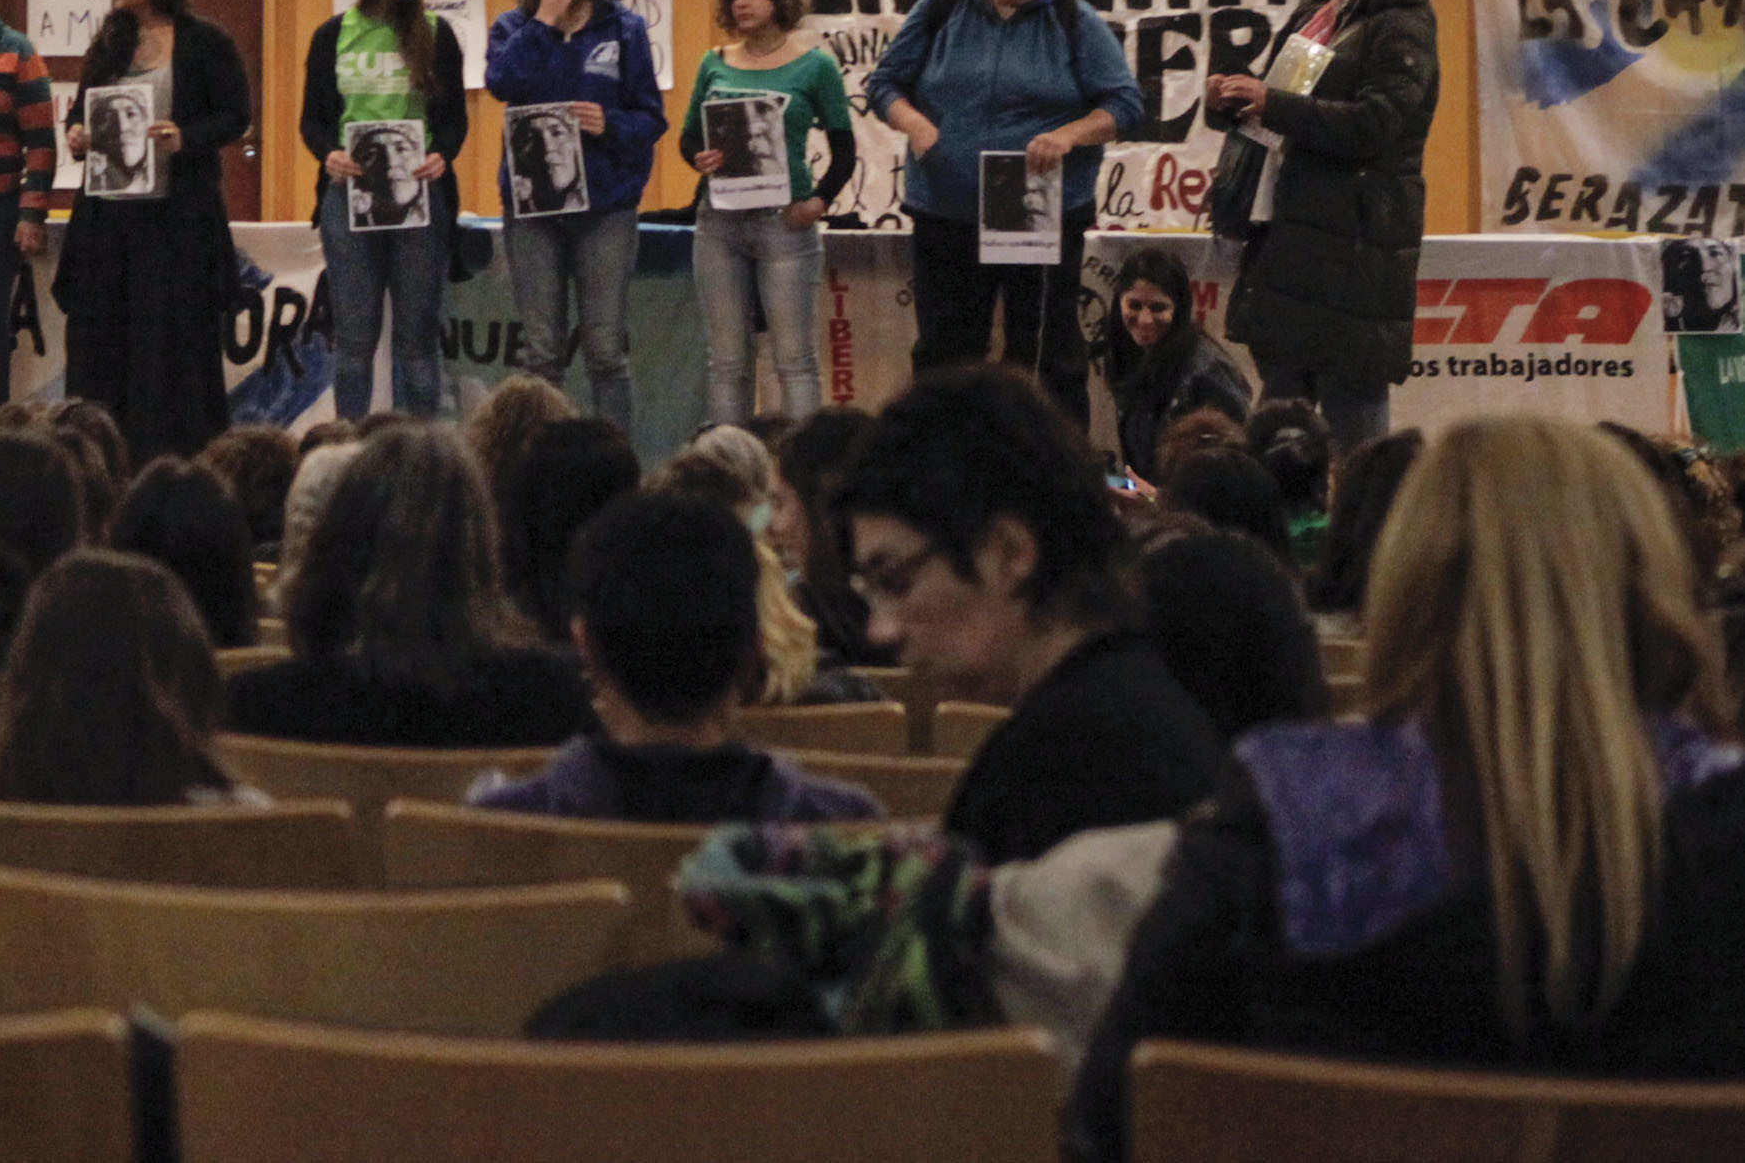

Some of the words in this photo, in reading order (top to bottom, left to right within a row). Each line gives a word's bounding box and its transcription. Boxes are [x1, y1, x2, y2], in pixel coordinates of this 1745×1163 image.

[1502, 167, 1745, 238] BERAZAT
[1407, 357, 1440, 378] os
[1447, 352, 1634, 382] trabajadores
